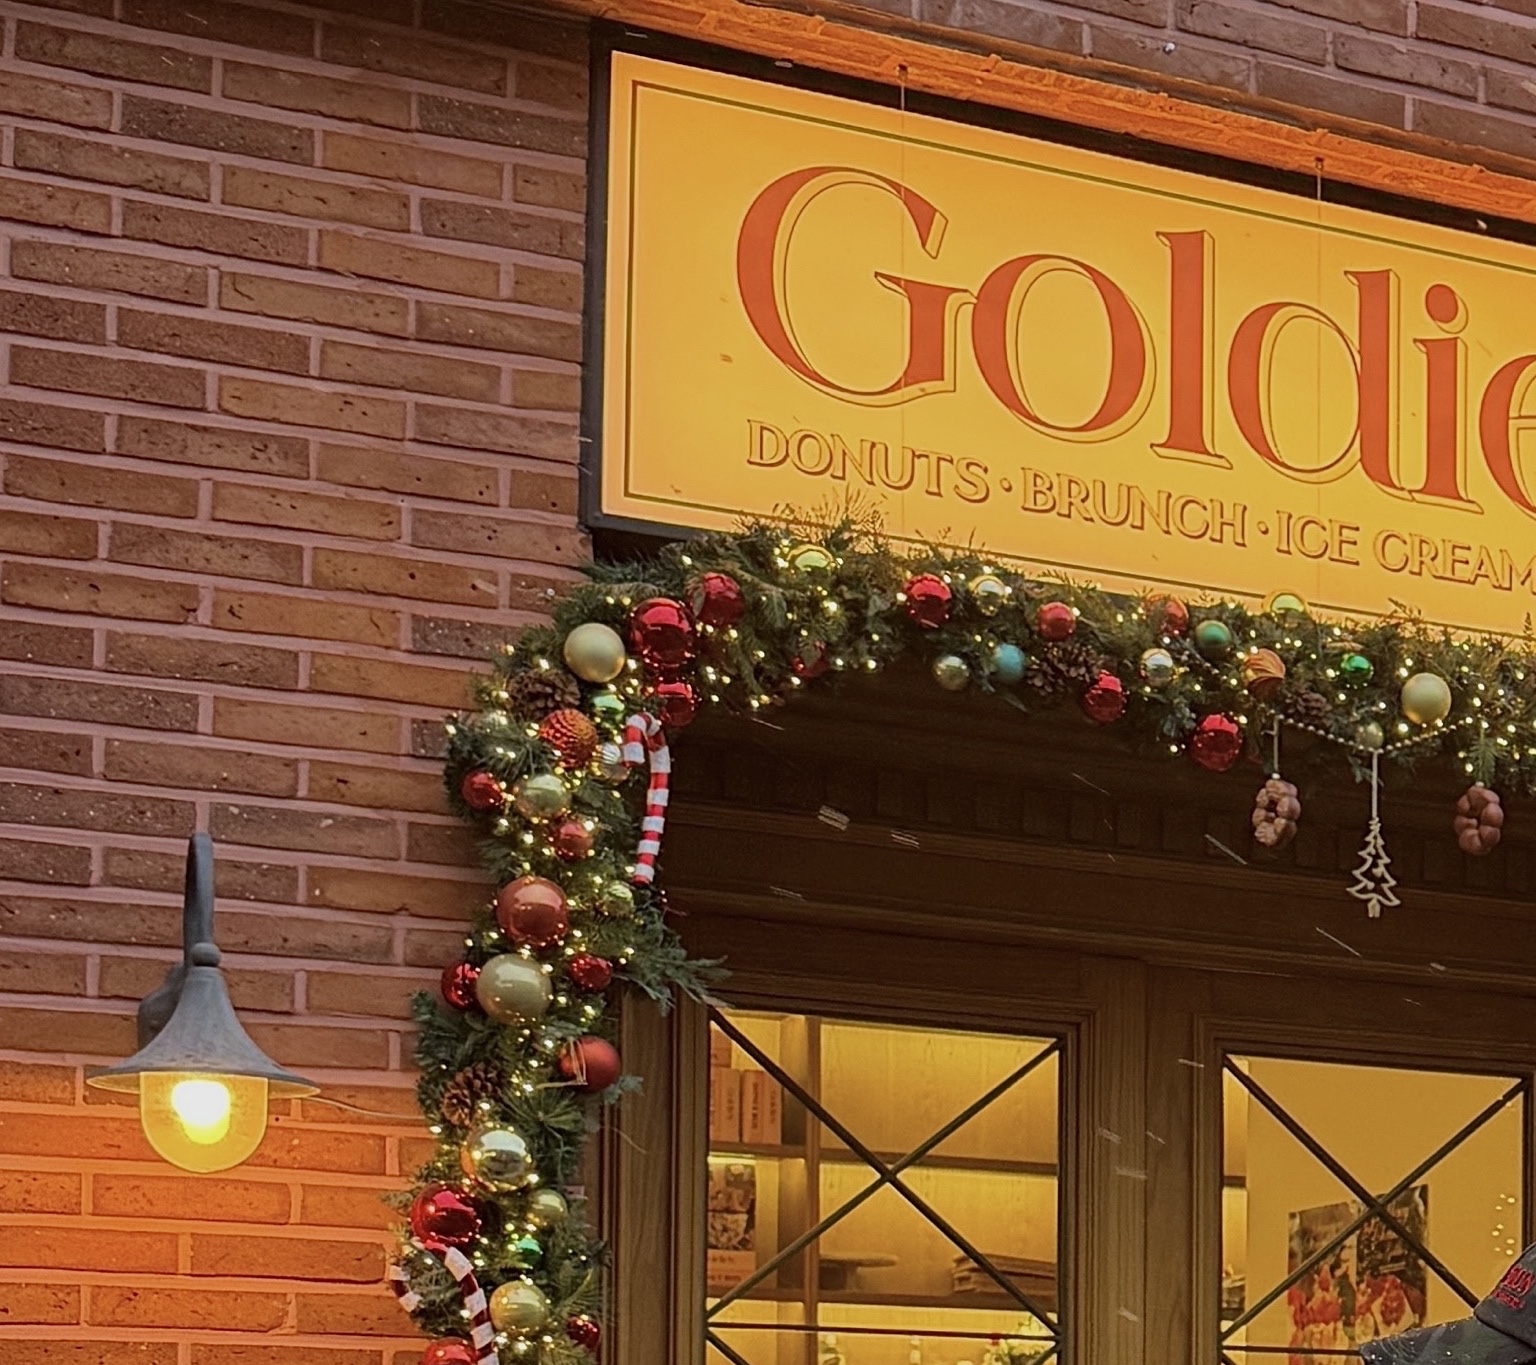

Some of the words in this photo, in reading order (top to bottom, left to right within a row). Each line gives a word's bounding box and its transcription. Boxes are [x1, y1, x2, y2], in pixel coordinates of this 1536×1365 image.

[746, 419, 990, 503] DONUTS
[1020, 467, 1247, 547] BRUNCH
[1276, 510, 1360, 565] ICE
